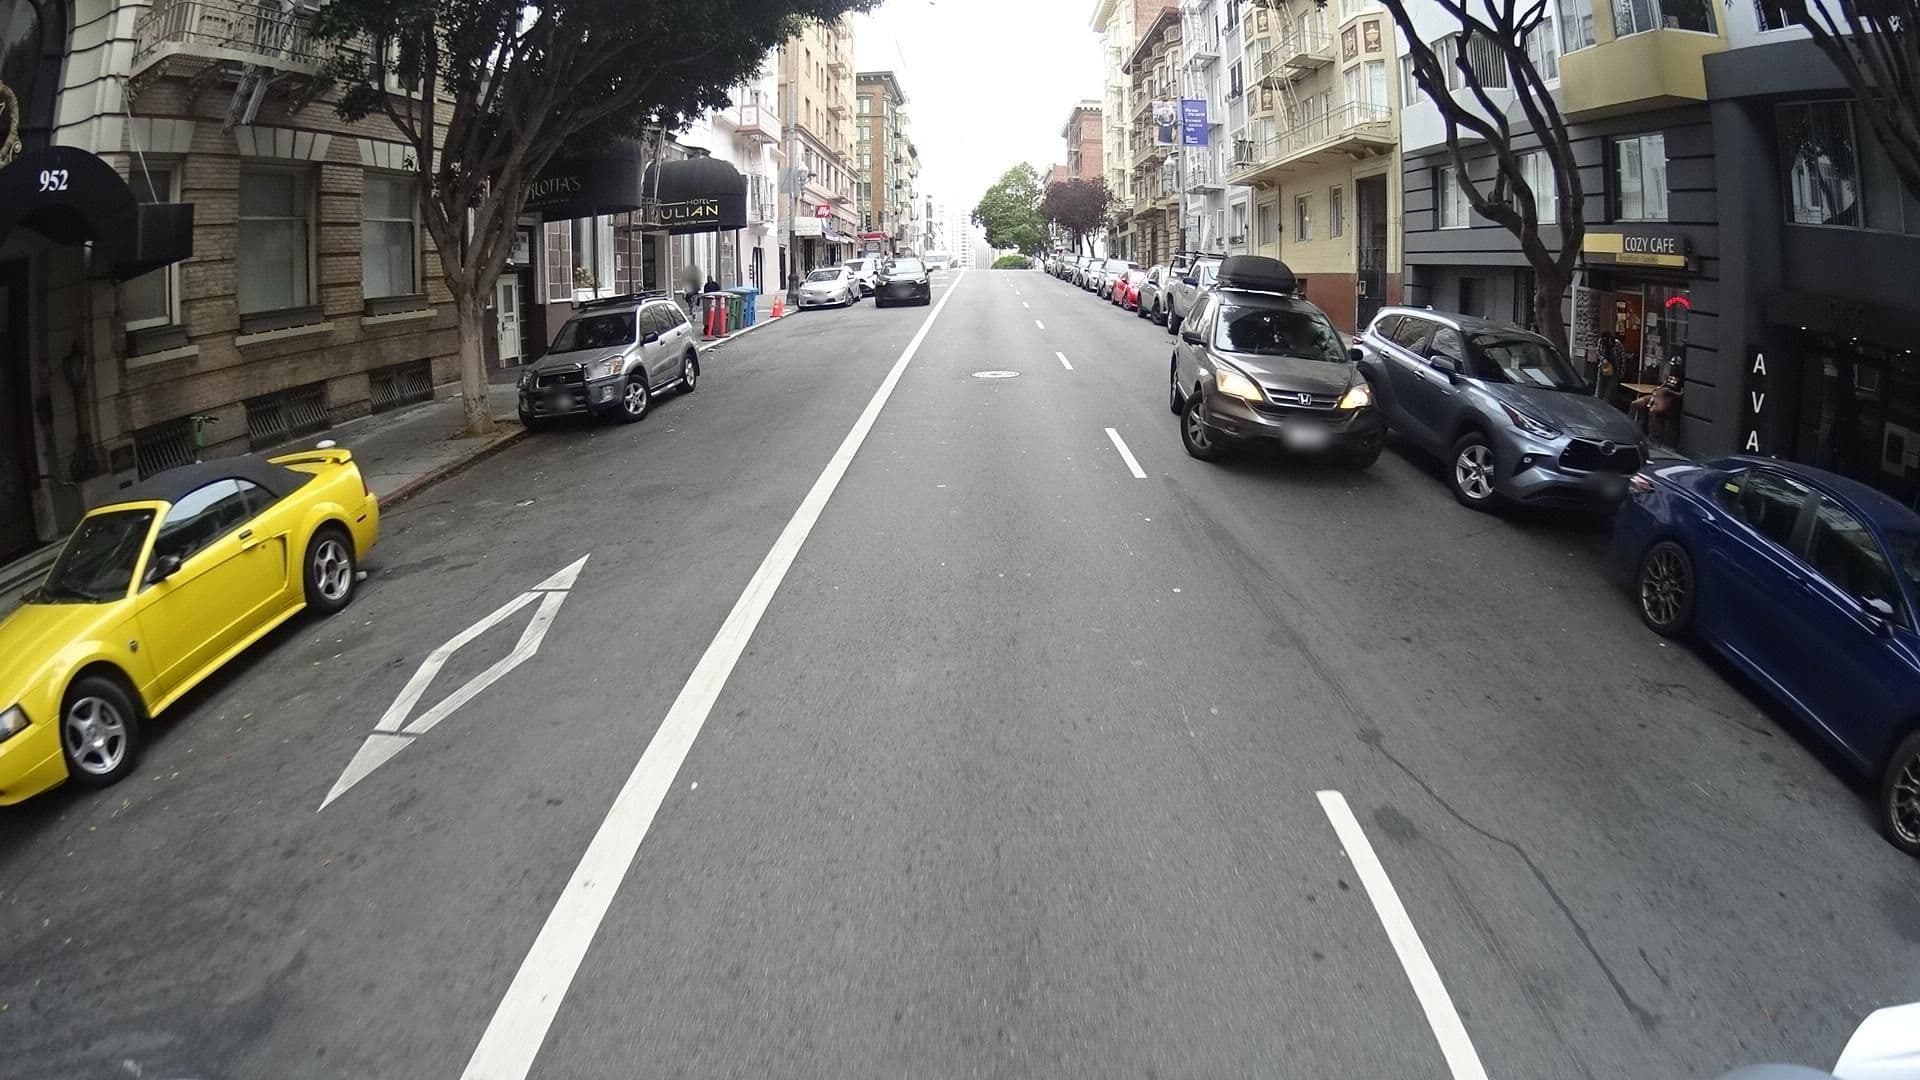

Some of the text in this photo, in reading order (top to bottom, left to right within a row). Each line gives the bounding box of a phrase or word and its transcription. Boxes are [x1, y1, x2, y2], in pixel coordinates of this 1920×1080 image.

[40, 169, 69, 192] 952
[686, 198, 710, 206] HOTEL
[661, 205, 719, 219] ULIAN
[1625, 237, 1675, 253] COZY CAFE
